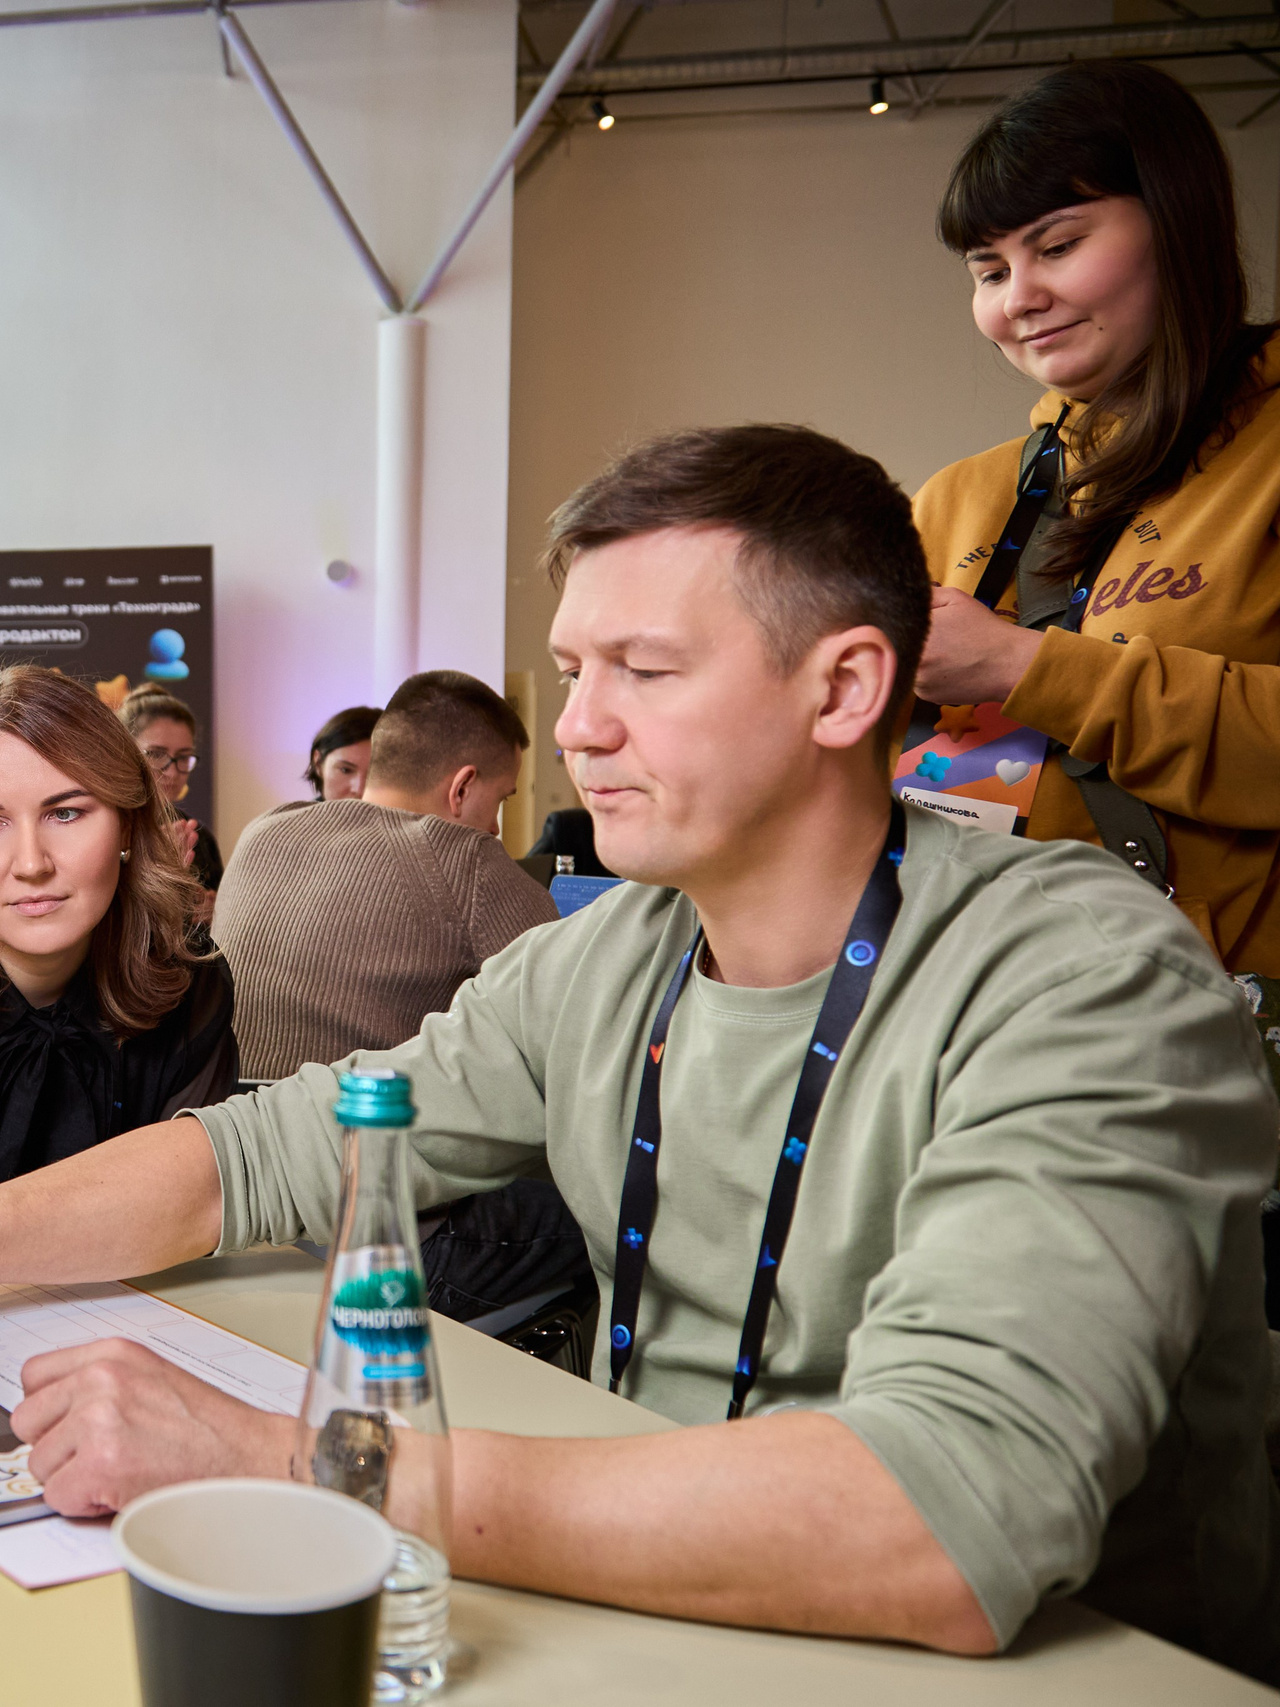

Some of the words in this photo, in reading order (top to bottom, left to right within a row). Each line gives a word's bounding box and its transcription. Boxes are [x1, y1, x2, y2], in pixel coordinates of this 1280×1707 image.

[1133, 520, 1161, 545] BUT
[955, 545, 991, 570] THE
[1082, 559, 1208, 622] eles
[71, 603, 111, 617] треки
